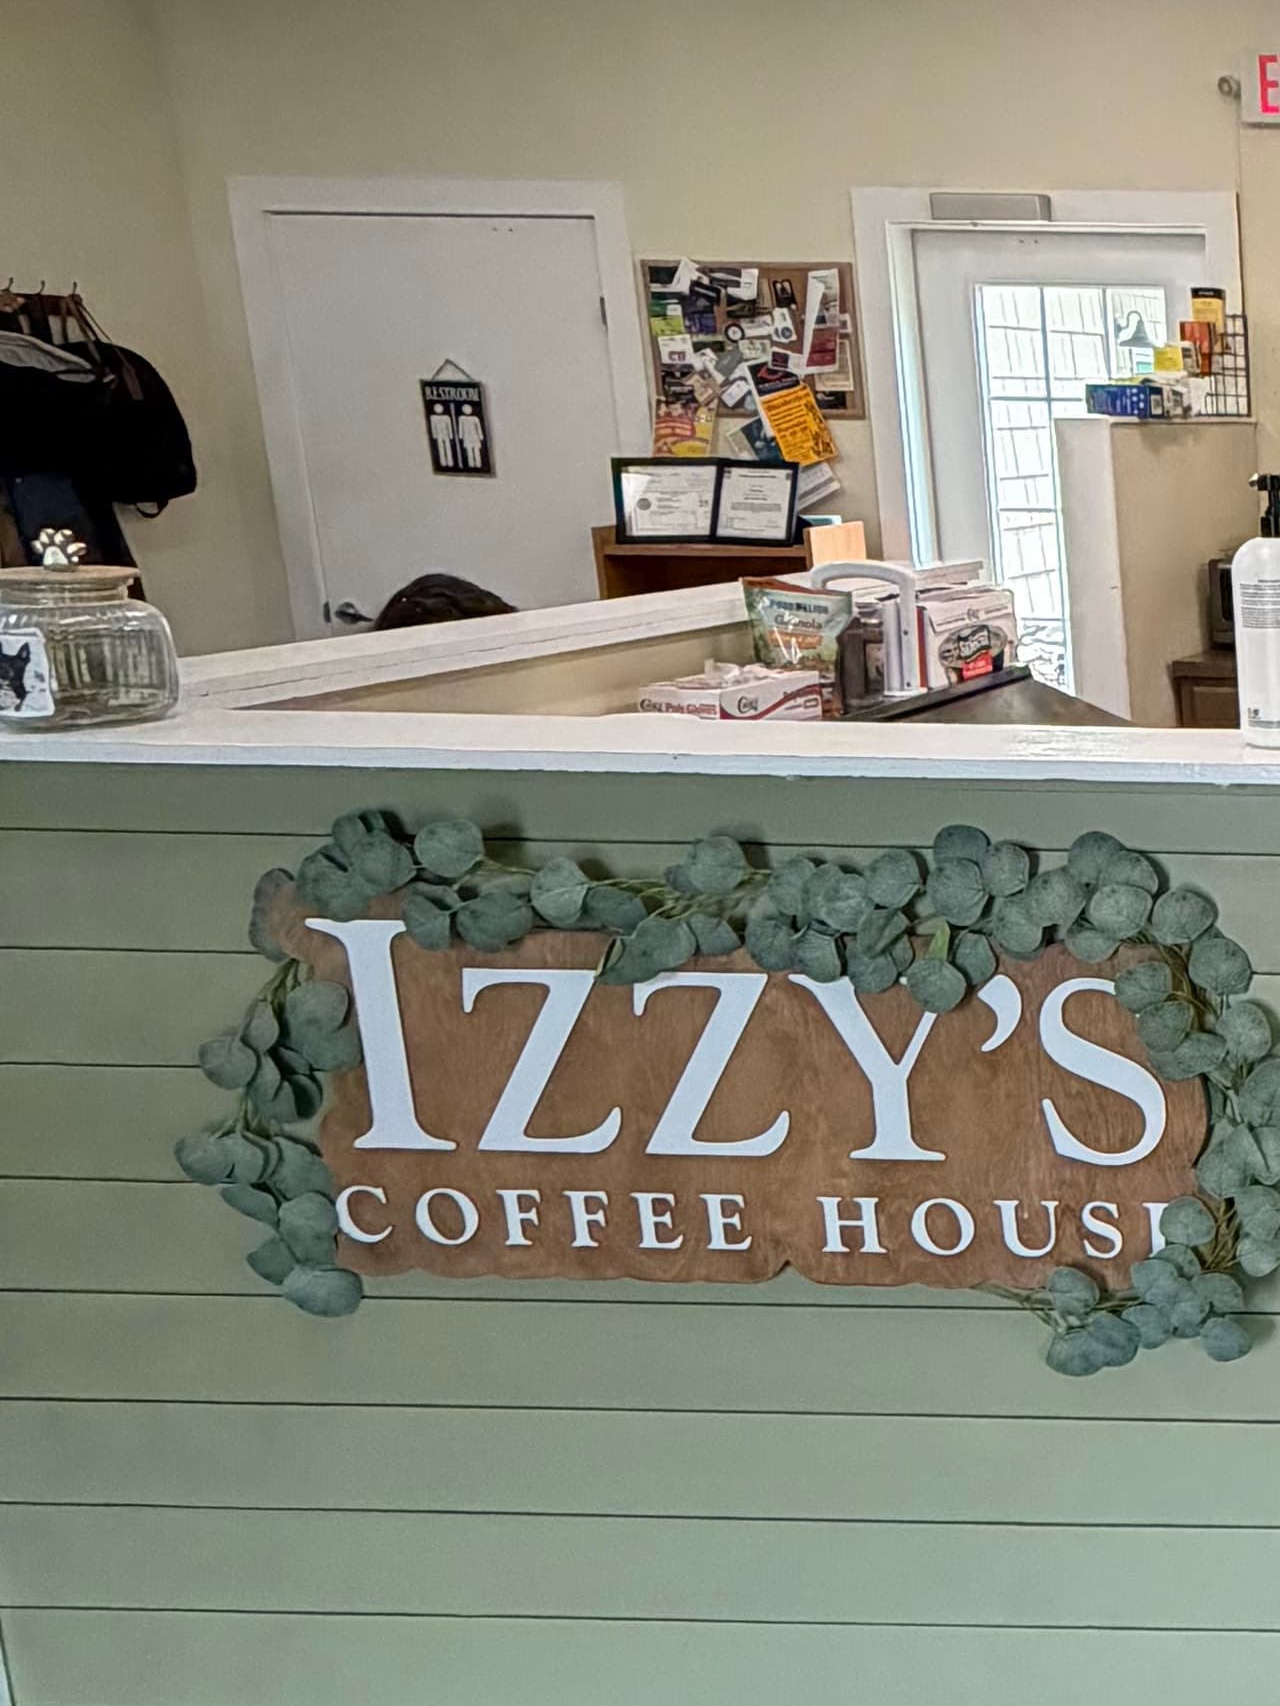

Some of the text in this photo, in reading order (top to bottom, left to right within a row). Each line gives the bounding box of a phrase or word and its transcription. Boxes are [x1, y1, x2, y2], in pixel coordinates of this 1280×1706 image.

[424, 386, 480, 401] RESTROOM
[774, 615, 823, 629] Gnola
[303, 916, 1167, 1167] IZZY'S
[335, 1184, 752, 1252] COFFEE
